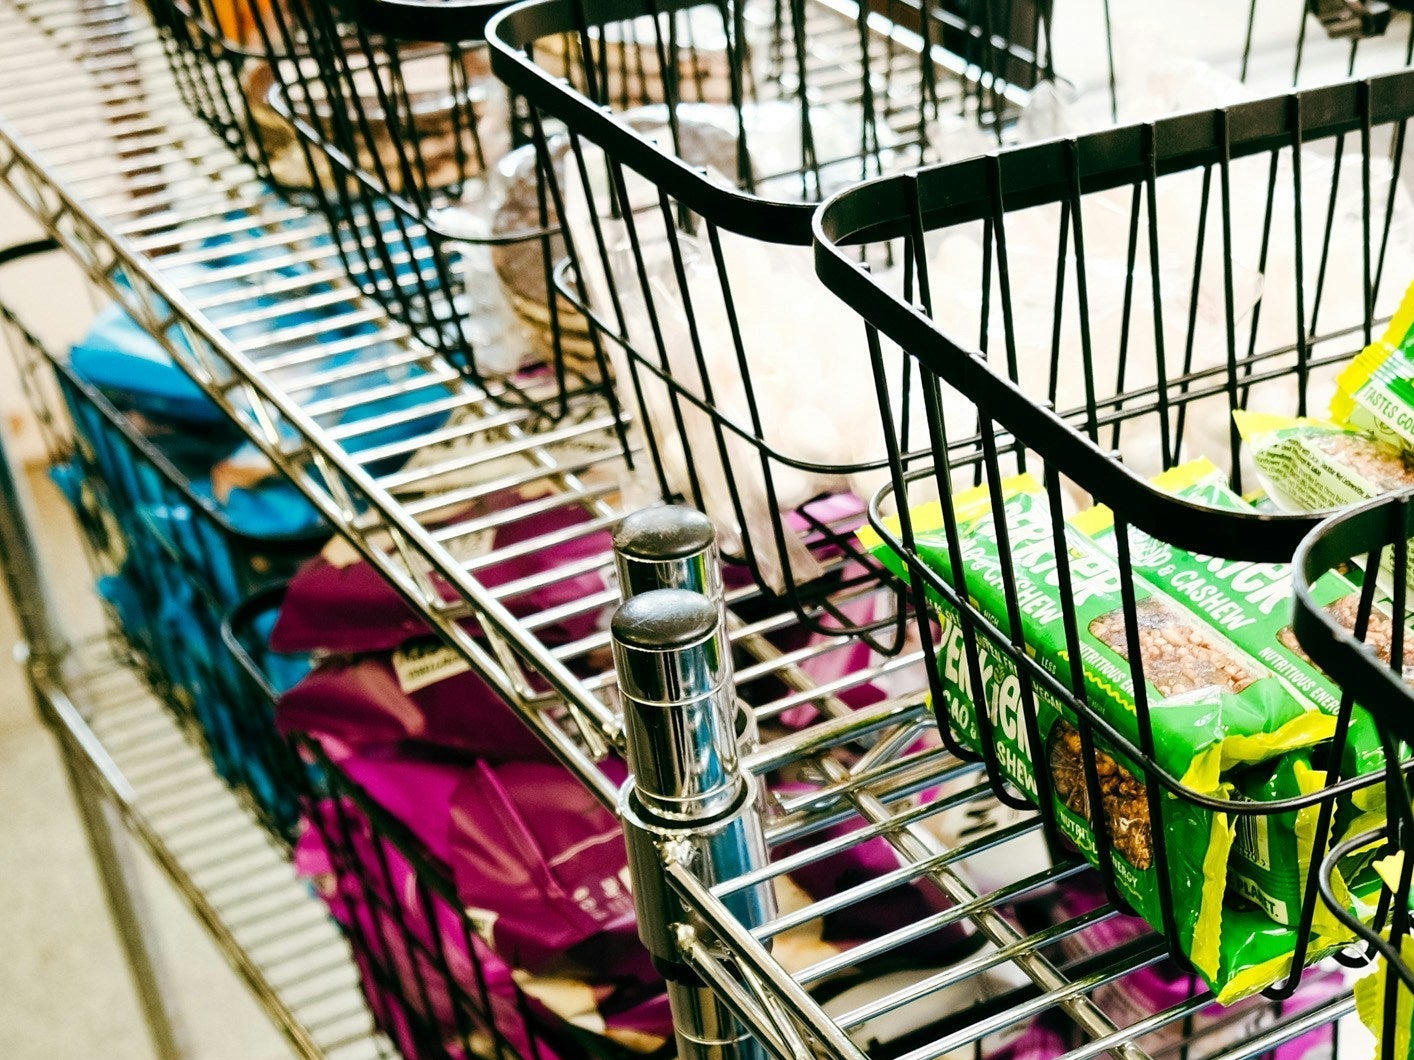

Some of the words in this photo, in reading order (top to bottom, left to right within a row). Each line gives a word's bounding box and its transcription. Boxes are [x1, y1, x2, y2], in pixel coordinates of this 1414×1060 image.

[1363, 385, 1397, 420] TASTES
[1170, 569, 1256, 631] CASHEW
[1259, 646, 1312, 692] NUTRITIOUS
[1308, 682, 1341, 715] ENERG
